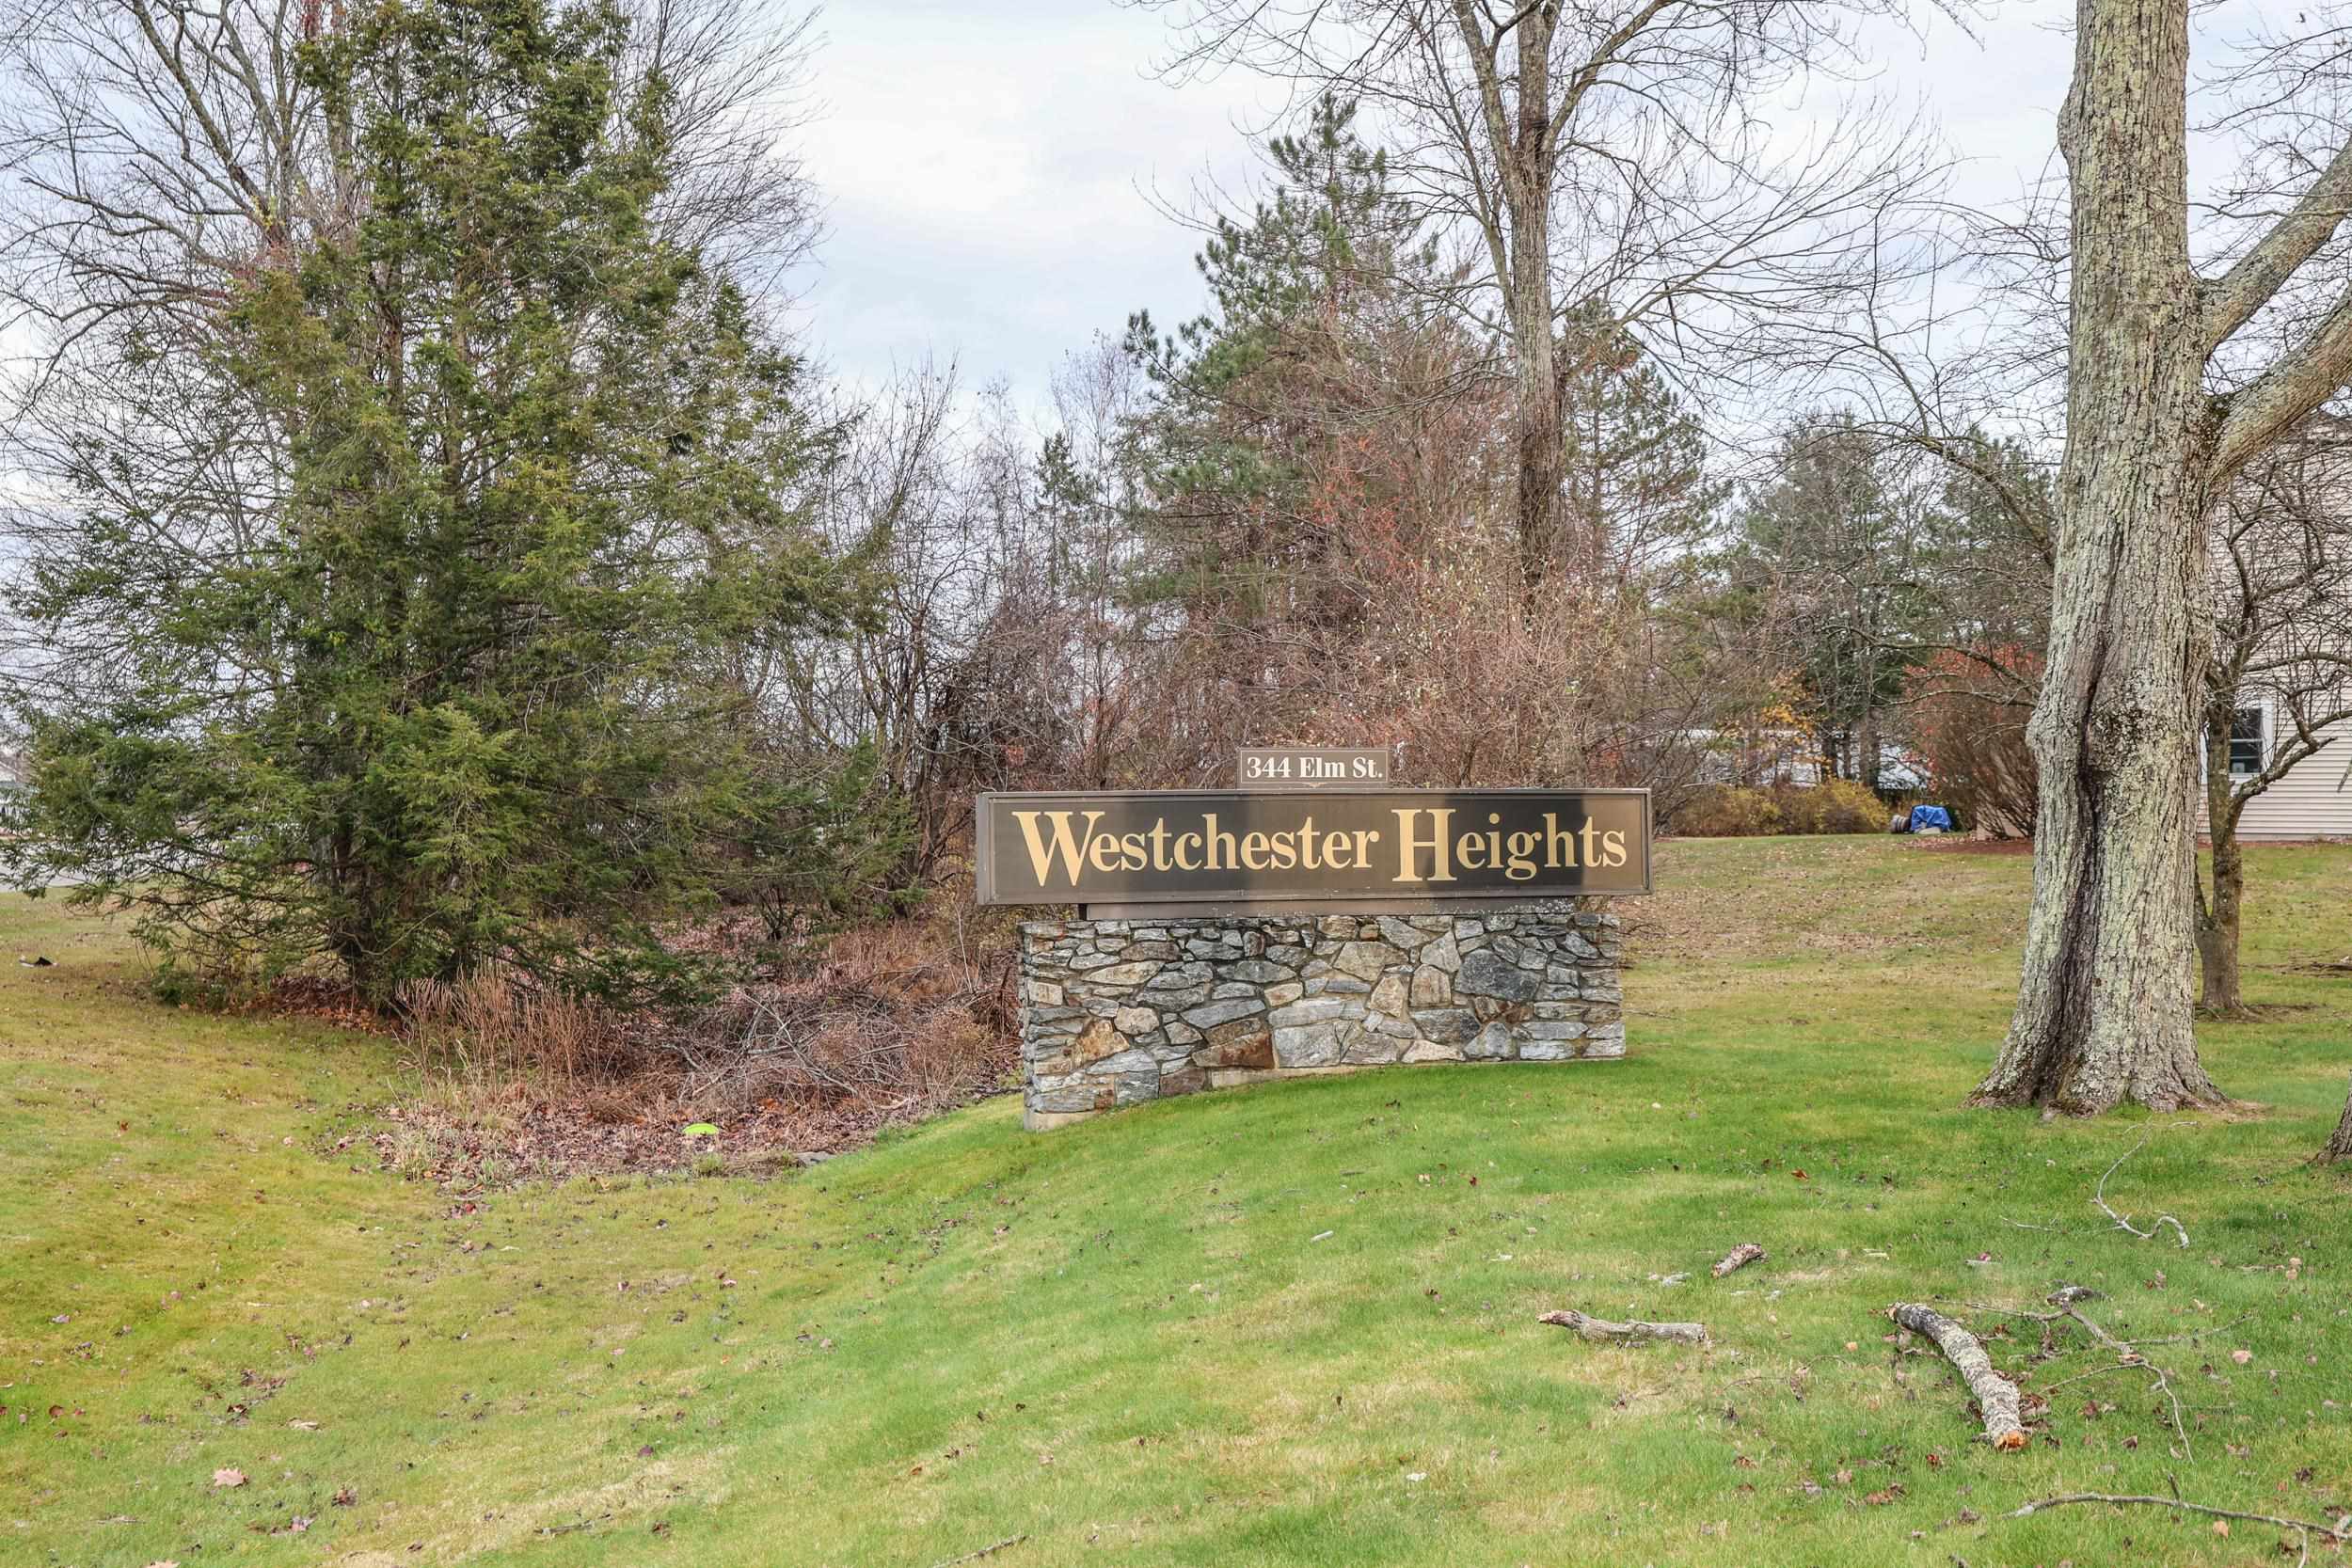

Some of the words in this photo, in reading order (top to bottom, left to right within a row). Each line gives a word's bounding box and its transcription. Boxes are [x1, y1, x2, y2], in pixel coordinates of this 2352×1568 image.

[1247, 756, 1292, 779] 344
[1299, 756, 1346, 779] Elm
[1352, 756, 1383, 779] St.
[1011, 810, 1380, 887] Westchester
[1391, 808, 1628, 882] Heights
